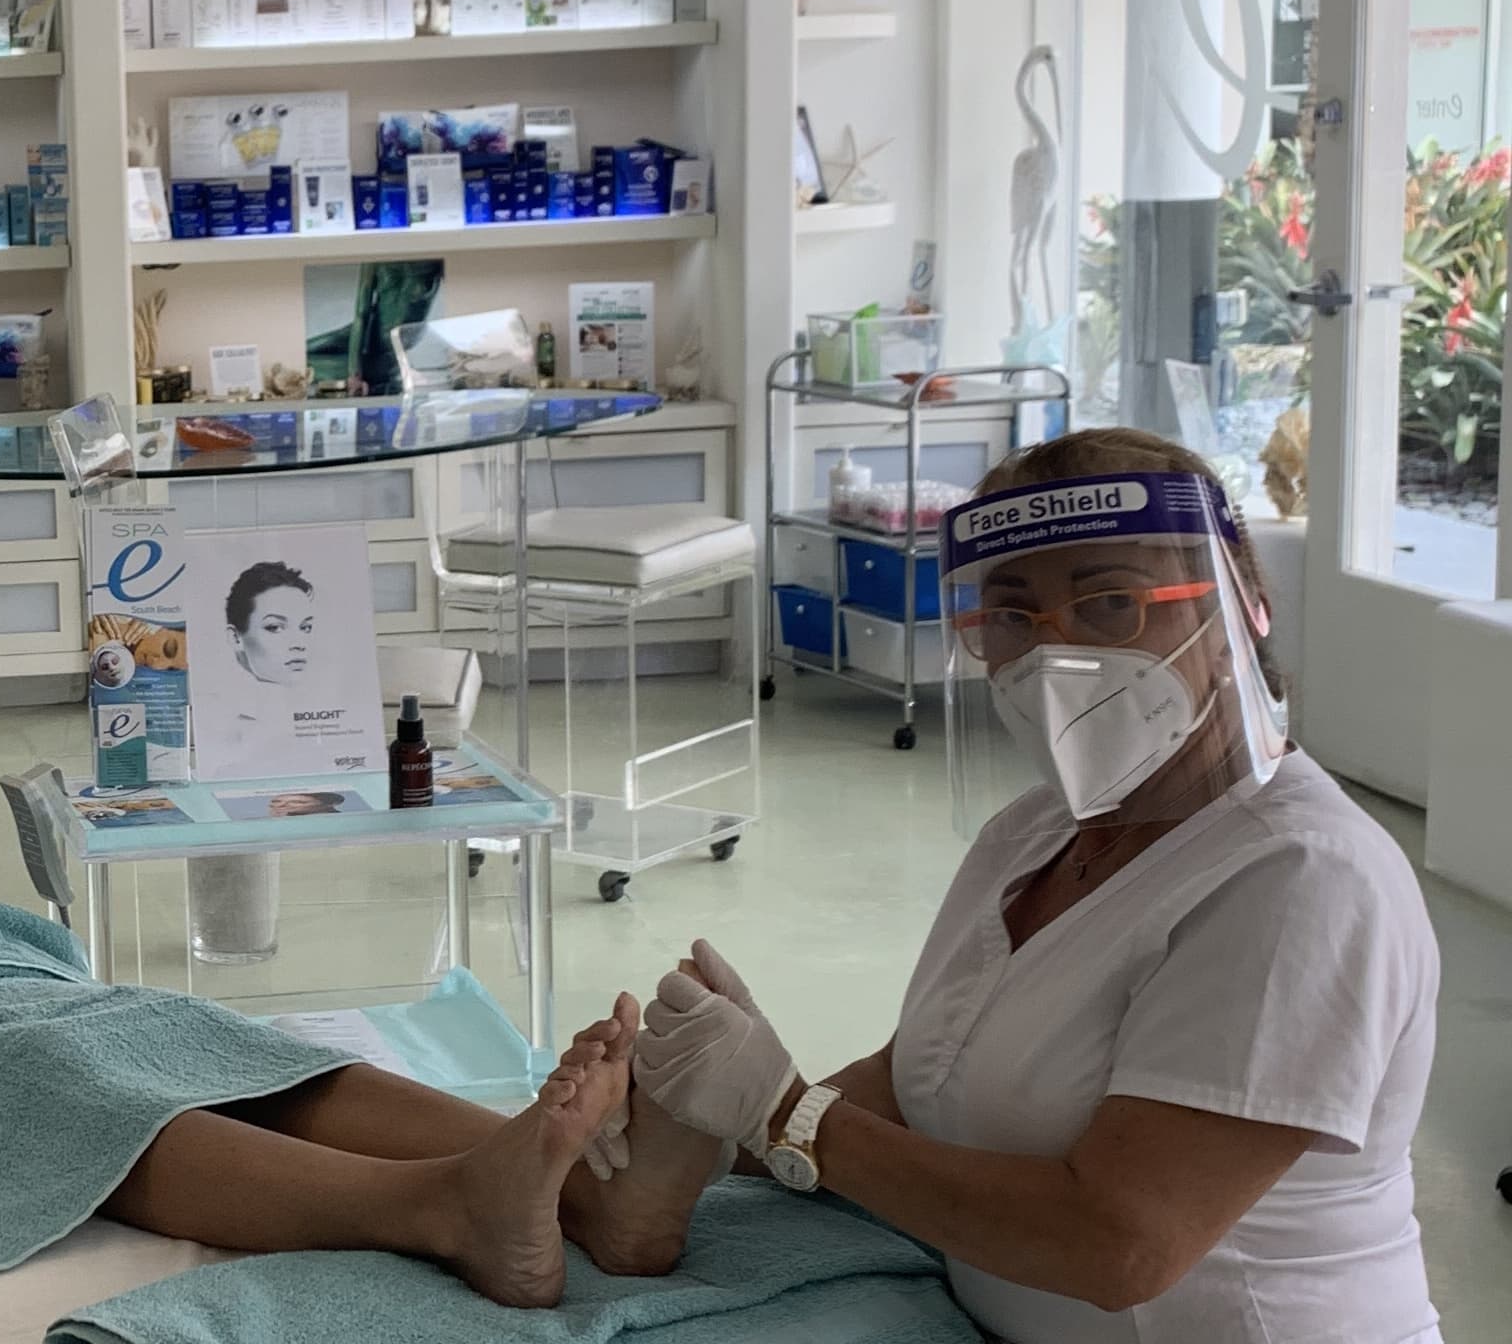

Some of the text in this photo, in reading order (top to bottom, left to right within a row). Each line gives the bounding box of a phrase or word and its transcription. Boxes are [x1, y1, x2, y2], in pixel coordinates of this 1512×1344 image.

[969, 488, 1122, 535] Face Shield
[112, 523, 168, 537] SPA
[976, 518, 1118, 553] Direct Splash Protection
